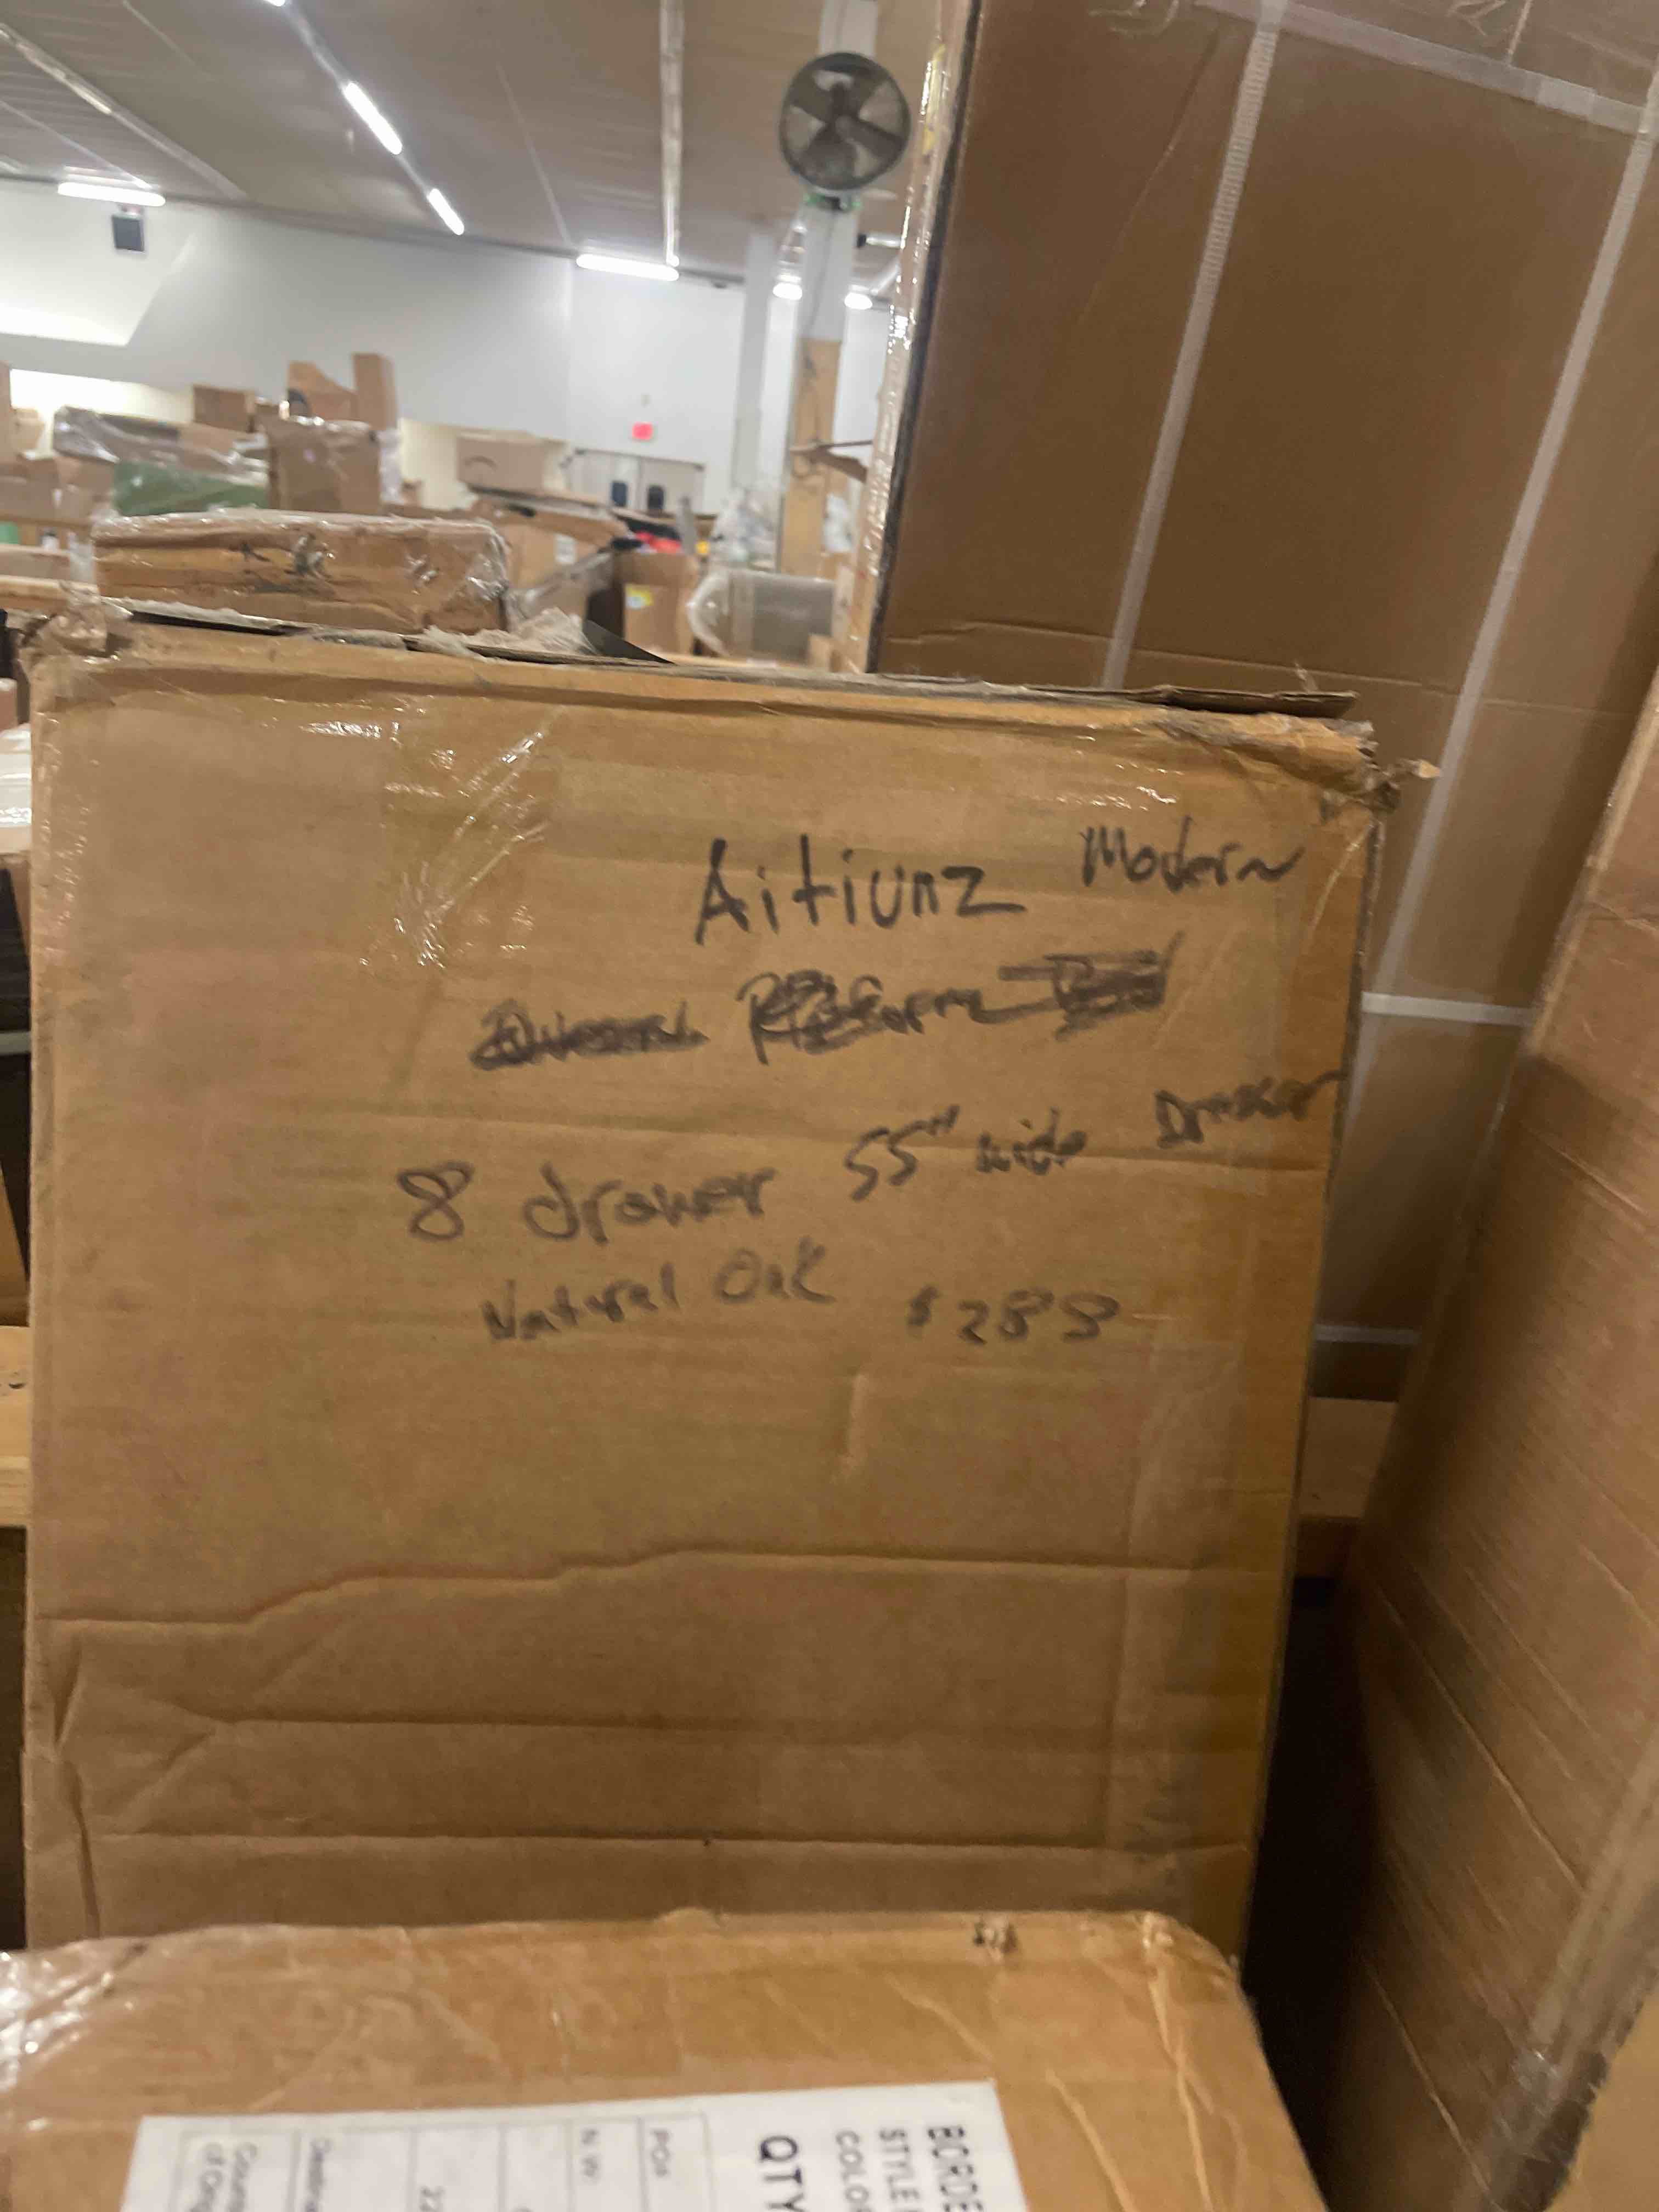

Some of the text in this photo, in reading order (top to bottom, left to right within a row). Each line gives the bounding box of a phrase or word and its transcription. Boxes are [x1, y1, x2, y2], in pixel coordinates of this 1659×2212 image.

[1080, 815, 1306, 894] Modern
[397, 1160, 475, 1241] 8
[524, 1160, 776, 1246] drawer
[479, 1261, 680, 1342] Natural
[715, 1236, 837, 1304] Oak
[757, 2135, 806, 2212] QTY
[878, 2128, 921, 2202] STYLE
